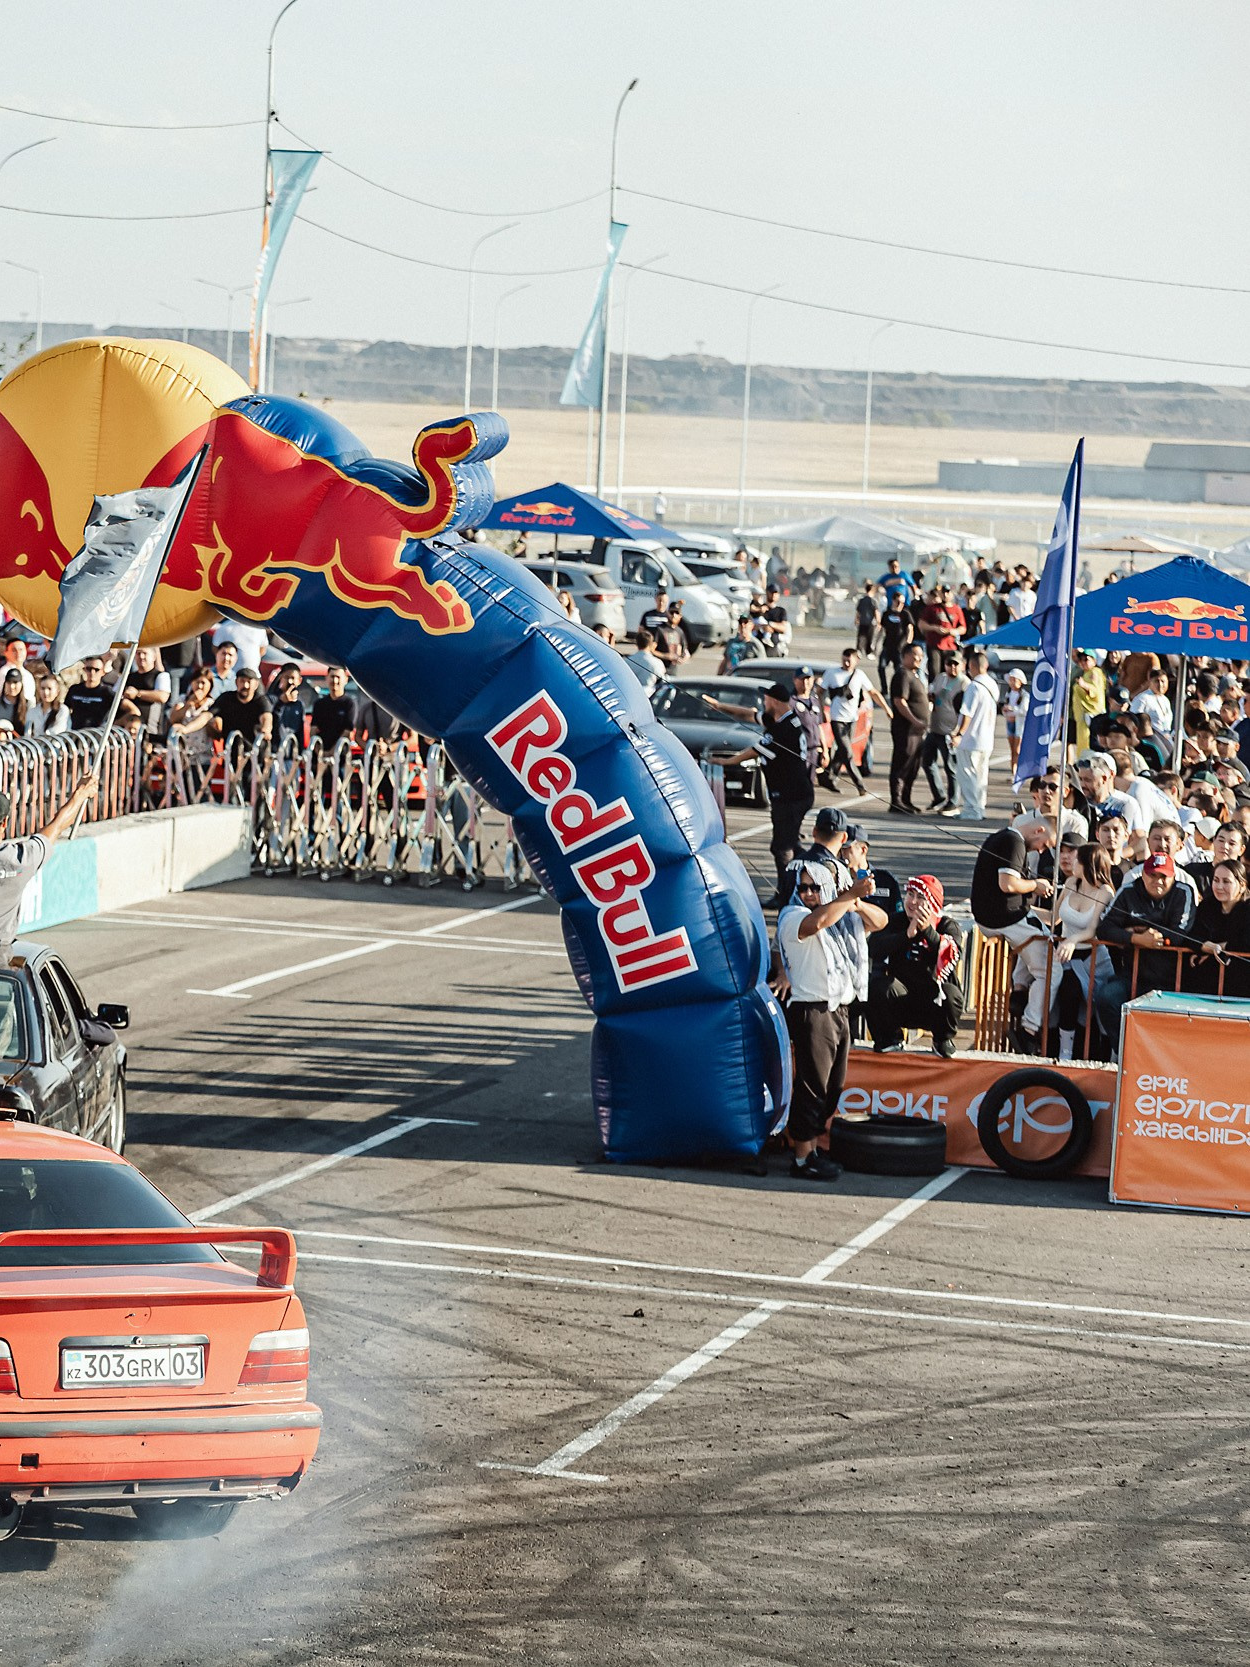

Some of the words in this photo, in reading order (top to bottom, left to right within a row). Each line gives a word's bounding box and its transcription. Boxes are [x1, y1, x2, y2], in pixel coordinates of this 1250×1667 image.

[500, 512, 536, 525] Red
[538, 514, 576, 527] Bull
[1110, 616, 1183, 638] Red
[487, 692, 631, 852] Red
[574, 838, 695, 990] Bull
[66, 1368, 82, 1379] KZ
[84, 1353, 165, 1379] 303GRK
[172, 1351, 199, 1376] 03
